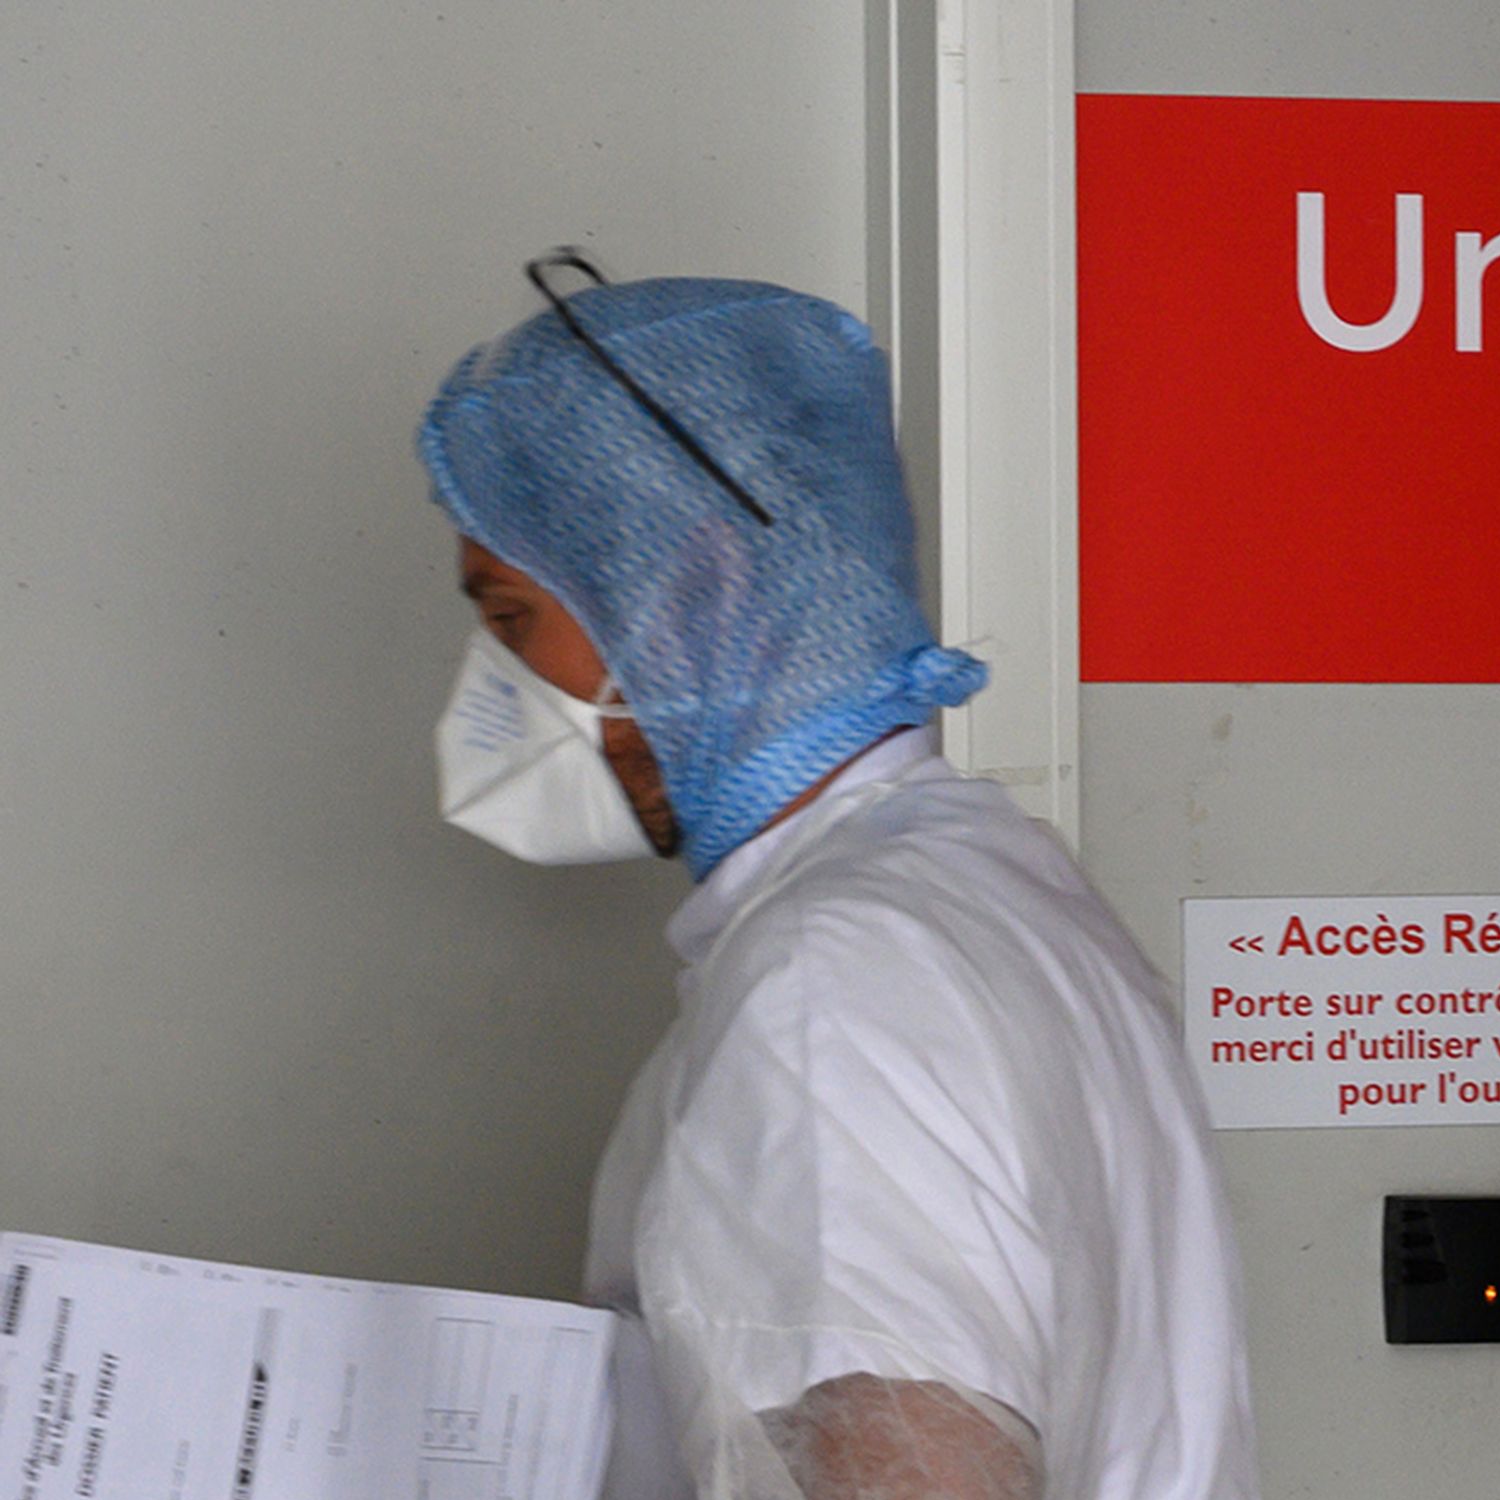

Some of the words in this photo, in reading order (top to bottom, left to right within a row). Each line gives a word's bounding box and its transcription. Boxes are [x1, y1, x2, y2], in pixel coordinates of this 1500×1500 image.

[1277, 913, 1426, 957] Accès
[1210, 985, 1314, 1019] Porte
[1326, 993, 1384, 1018] sur
[1210, 1030, 1314, 1064] merci
[1325, 1028, 1481, 1062] d'utiliser
[1338, 1082, 1426, 1116] pour
